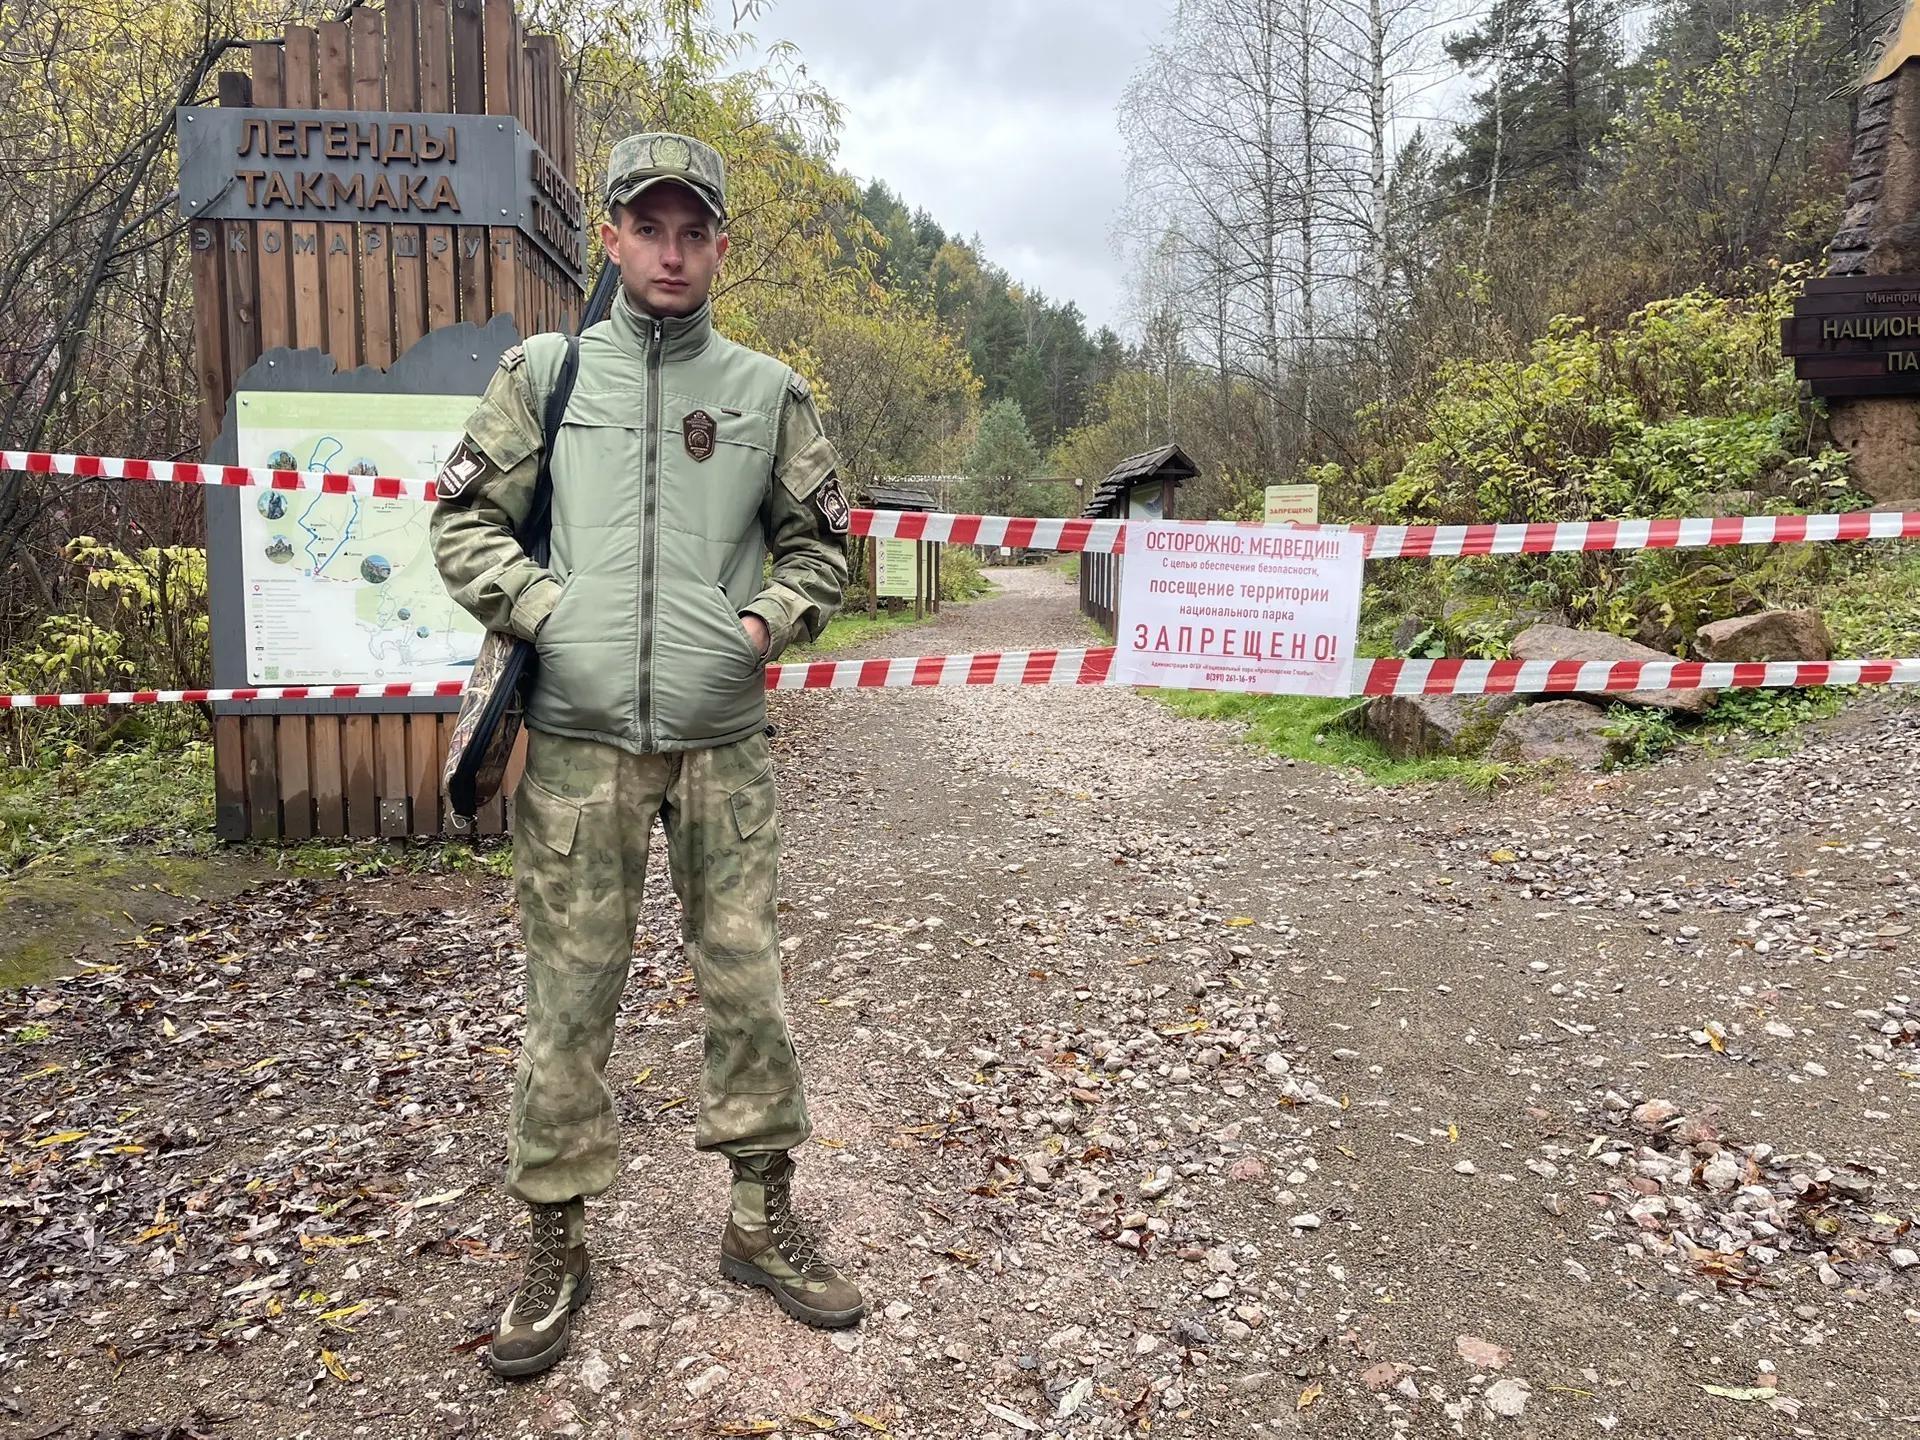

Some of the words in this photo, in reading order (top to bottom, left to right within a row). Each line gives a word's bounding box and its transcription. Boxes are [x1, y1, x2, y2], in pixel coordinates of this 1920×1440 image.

[236, 118, 457, 164] ЛЕГЕНДЫ
[235, 170, 461, 213] ТАКМАКА
[194, 228, 512, 261] ЭКОМАРШРУТ
[1865, 292, 1920, 305] Минпри
[1269, 507, 1314, 515] ЗАПРЕЩЕНО
[1146, 531, 1245, 553] ОСТОРОЖНО:
[1250, 537, 1340, 560] МЕДВЕДИ!!!
[1162, 558, 1169, 568] С
[1171, 560, 1198, 571] целью
[1200, 560, 1256, 573] обеспечения
[1258, 563, 1320, 577] безопасности,
[1150, 579, 1234, 598] посещение
[1240, 584, 1330, 604] территории
[1179, 604, 1259, 620] национального
[1262, 609, 1295, 622] парка
[1133, 623, 1337, 661] ЗАПРЕЩЕНО!
[1206, 672, 1225, 682] 8(391)
[1226, 674, 1257, 684] 261-16-95
